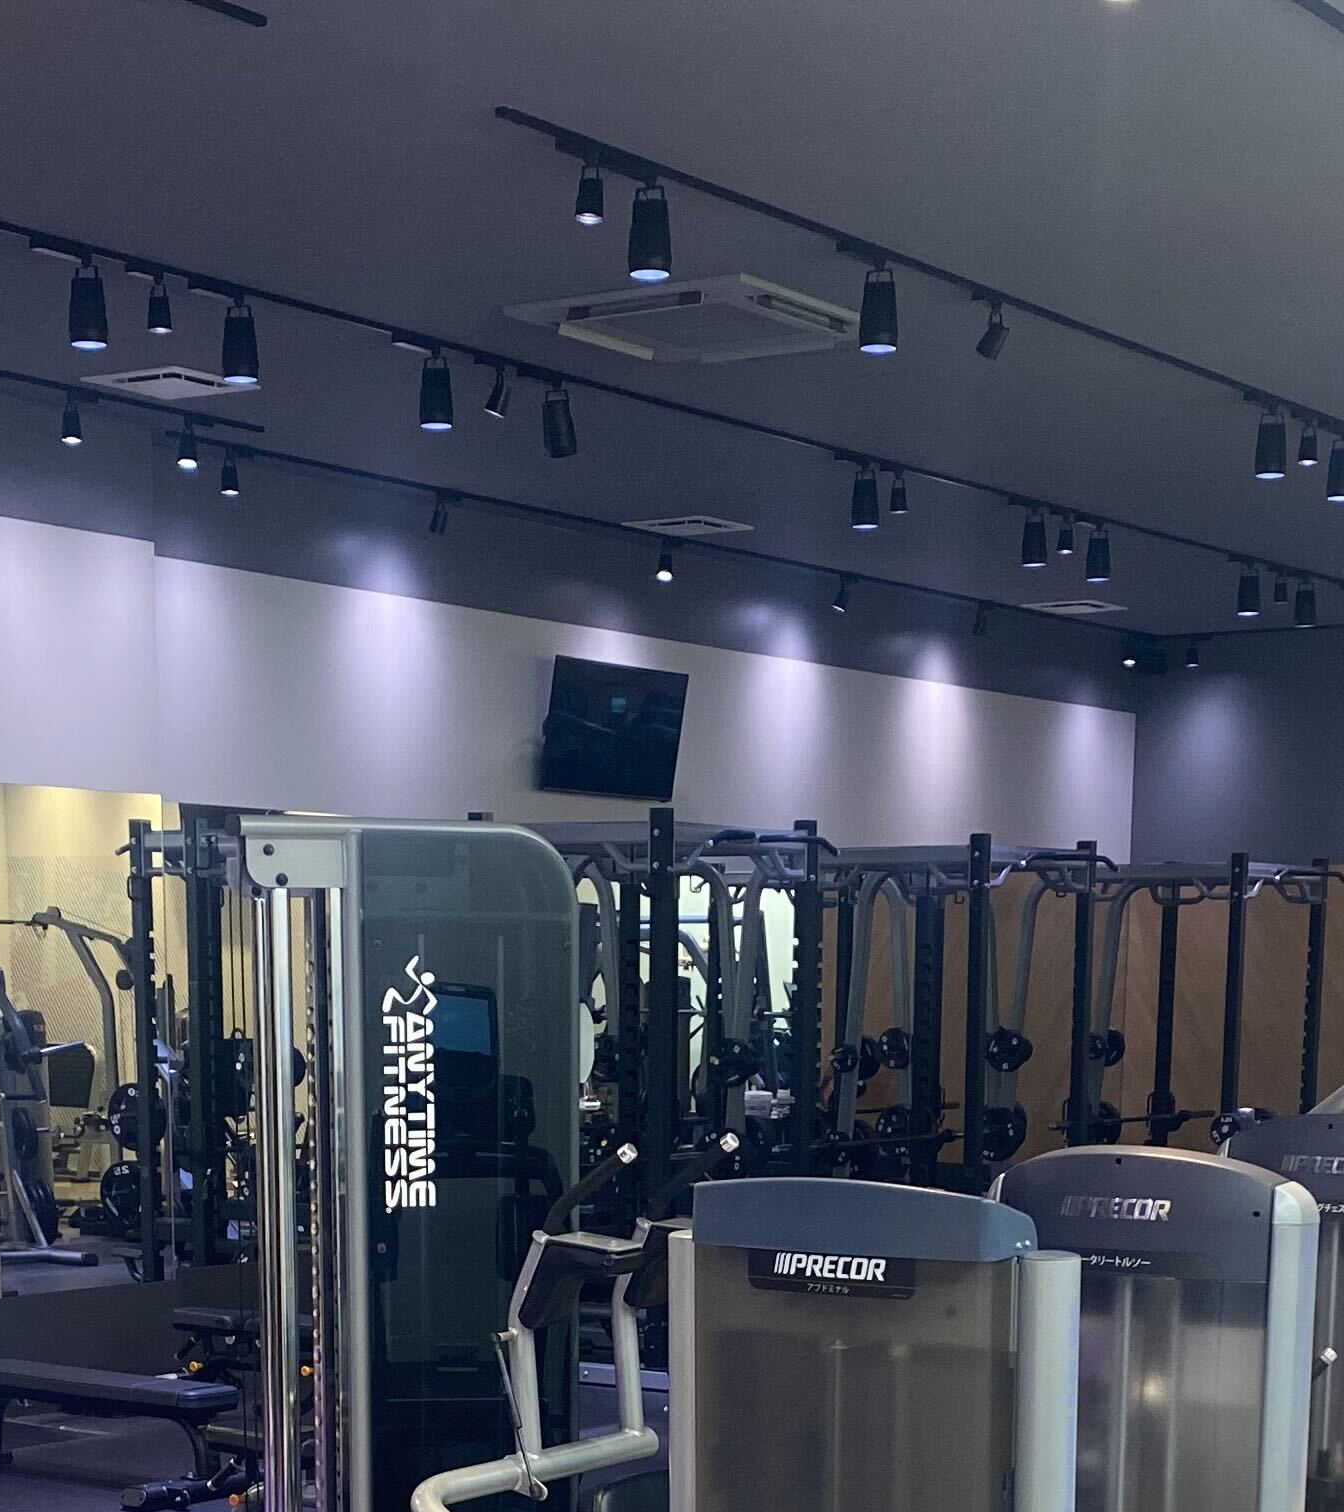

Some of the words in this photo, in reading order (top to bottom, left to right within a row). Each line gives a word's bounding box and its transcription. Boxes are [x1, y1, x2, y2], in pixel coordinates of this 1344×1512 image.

[382, 1014, 408, 1208] FITNESS
[406, 1011, 437, 1209] ANYTIME
[789, 1253, 887, 1283] PRECOR
[1081, 1254, 1152, 1268] ータリートルソー
